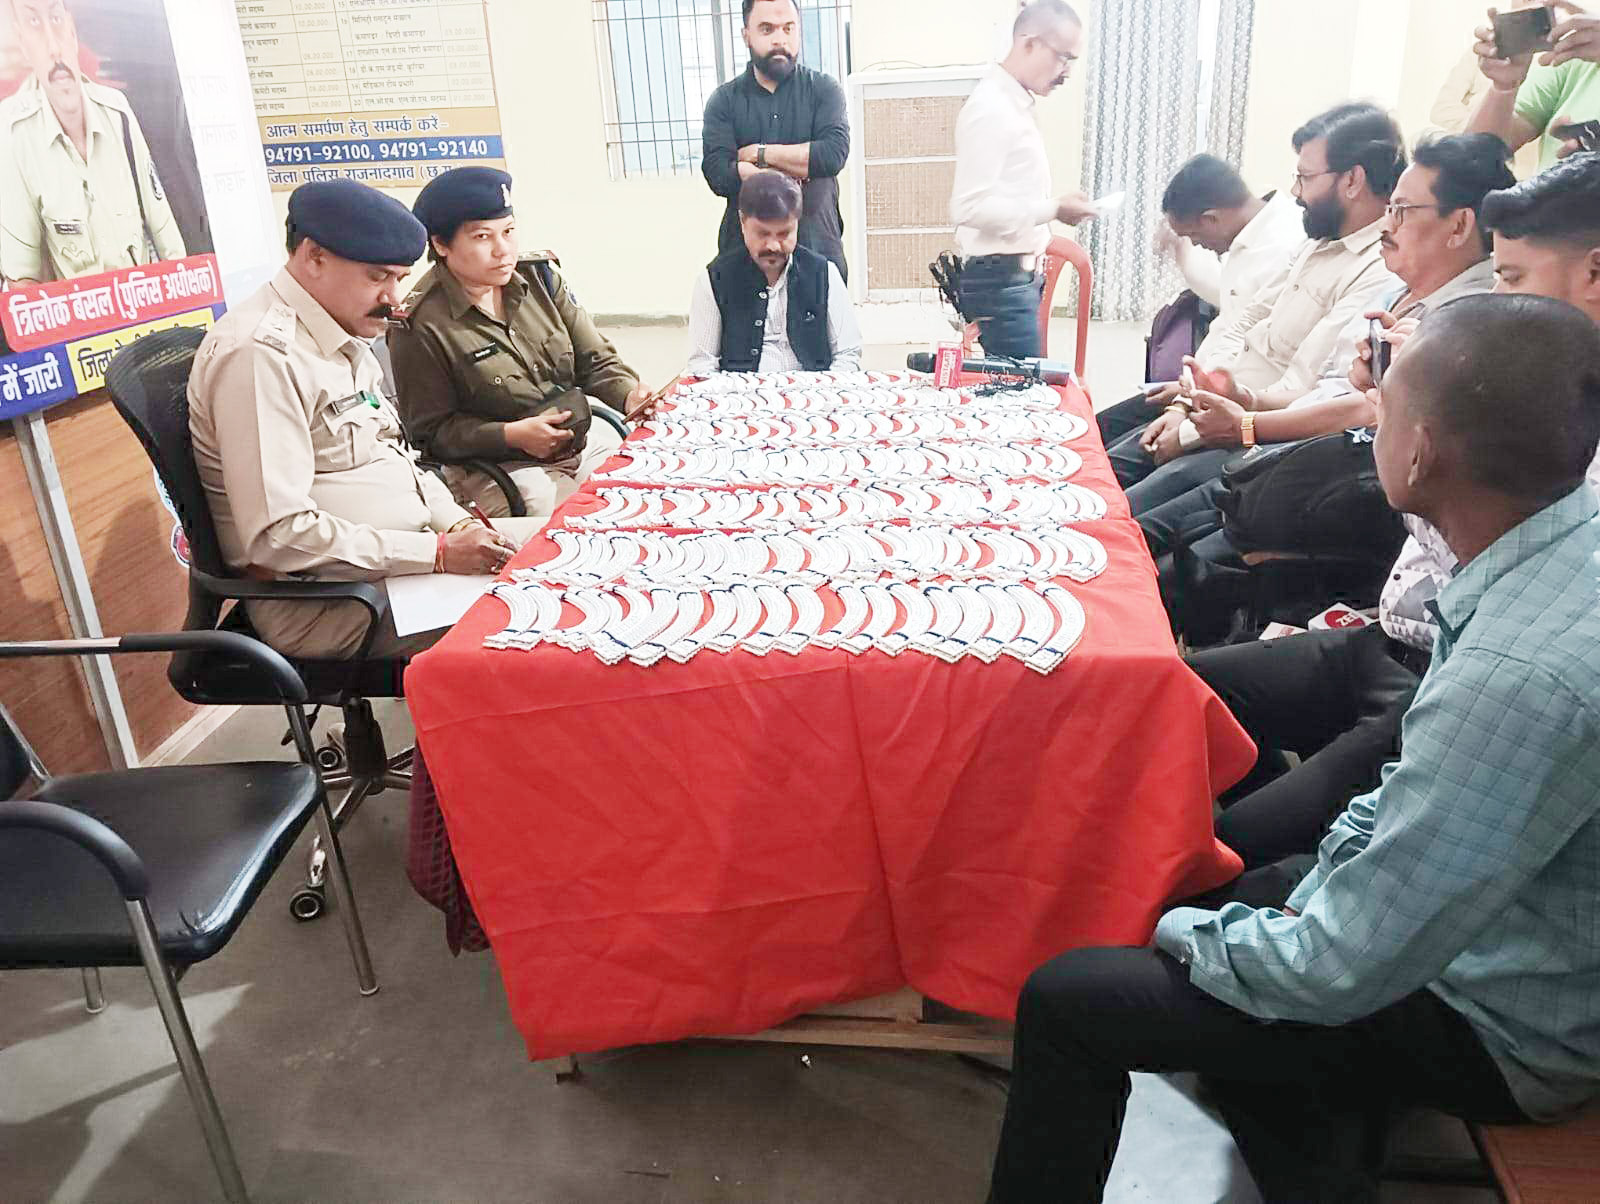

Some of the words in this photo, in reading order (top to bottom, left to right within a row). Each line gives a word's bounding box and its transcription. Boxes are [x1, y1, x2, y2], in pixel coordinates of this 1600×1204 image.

[267, 124, 297, 138] आत्म
[303, 120, 344, 136] समर्पण
[350, 119, 369, 138] हेतु
[373, 116, 412, 132] सम्पर्क
[380, 140, 488, 158] 94791-92140
[8, 289, 71, 337] त्रिलोक
[69, 284, 115, 321] बंसल
[19, 352, 63, 395] जारी
